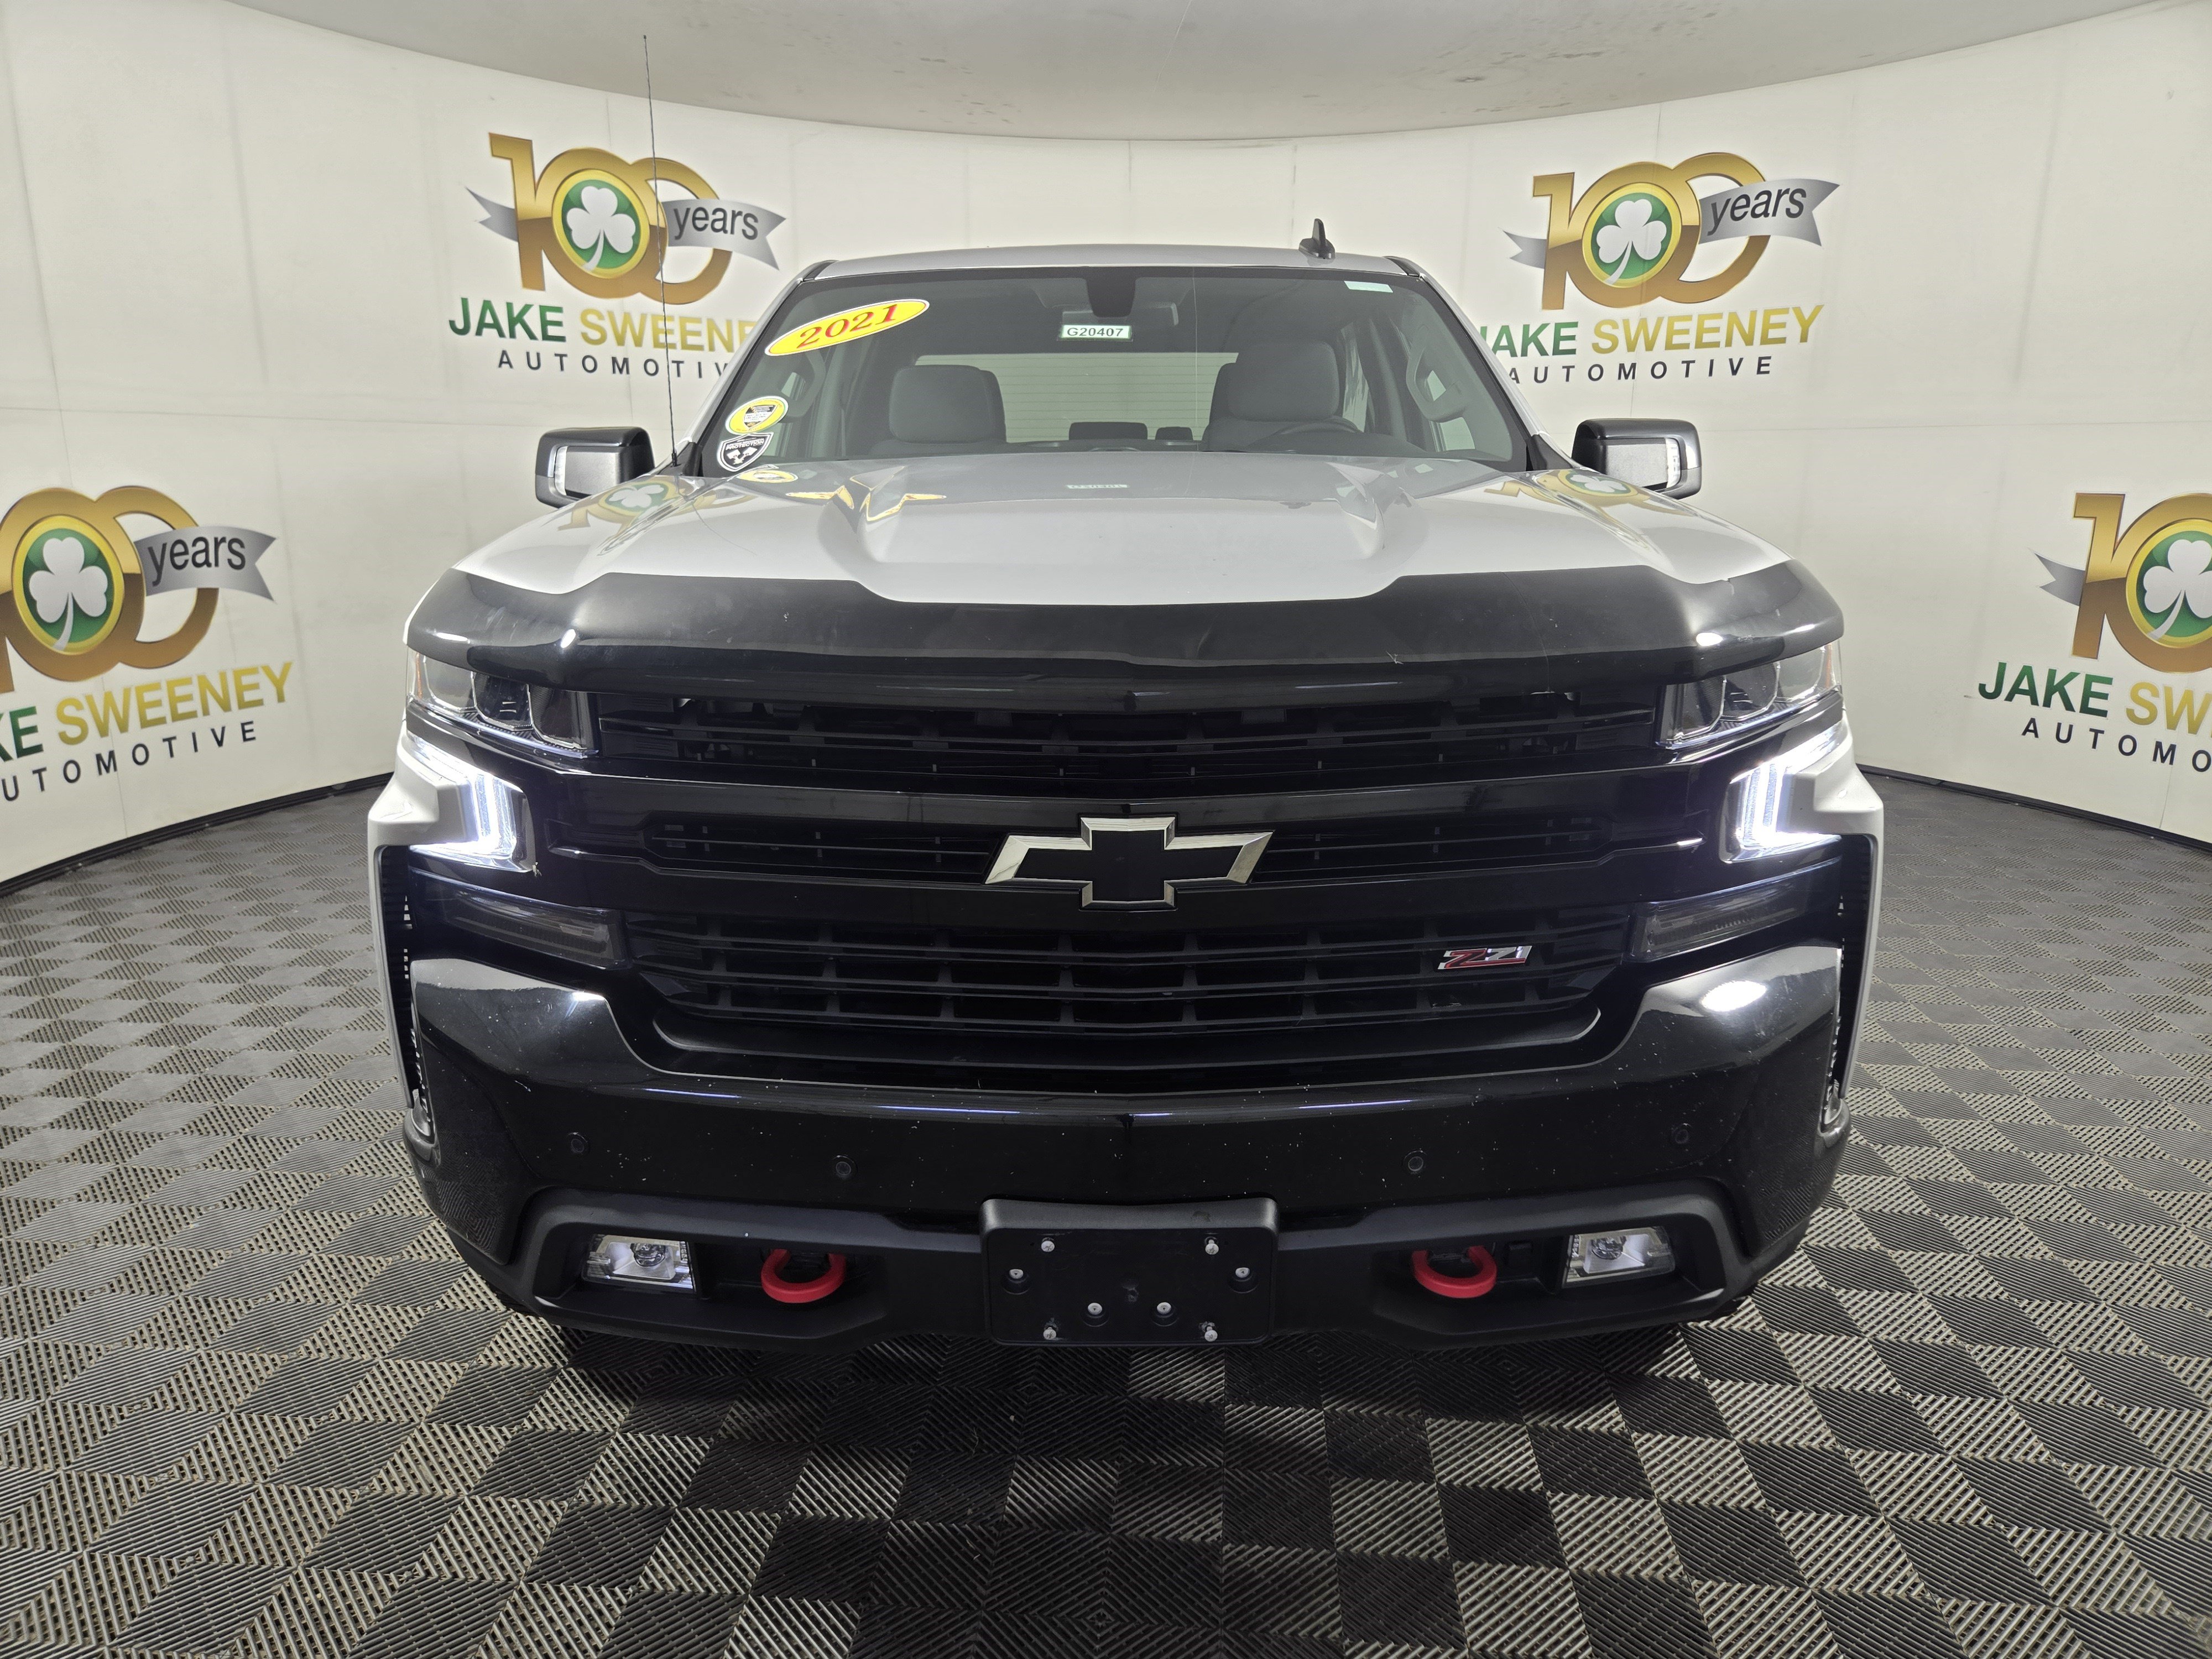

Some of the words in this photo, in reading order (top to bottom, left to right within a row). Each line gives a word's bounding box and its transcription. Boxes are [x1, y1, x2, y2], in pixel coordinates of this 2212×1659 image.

[488, 132, 733, 305] 100
[673, 205, 759, 241] years
[1532, 152, 1771, 310] 100
[1707, 186, 1807, 236] years
[448, 297, 566, 342] JAKE
[580, 309, 757, 353] SWEEN
[796, 304, 898, 349] 2021
[1067, 327, 1124, 337] G20407
[1592, 305, 1824, 354] SWEENEY
[498, 349, 728, 379] AUTOMOTIV
[1509, 356, 1772, 384] AUTOMOTIVE
[726, 440, 764, 450] PROTECTION
[0, 486, 220, 692] 00
[148, 536, 246, 587] years
[2073, 492, 2212, 674] 10
[56, 661, 293, 746] SWEENEY
[1978, 661, 2114, 718] JAKE
[2, 720, 257, 802] UTOMOTIVE
[2021, 717, 2211, 773] AUTOMO
[1438, 945, 1532, 969] Z71
